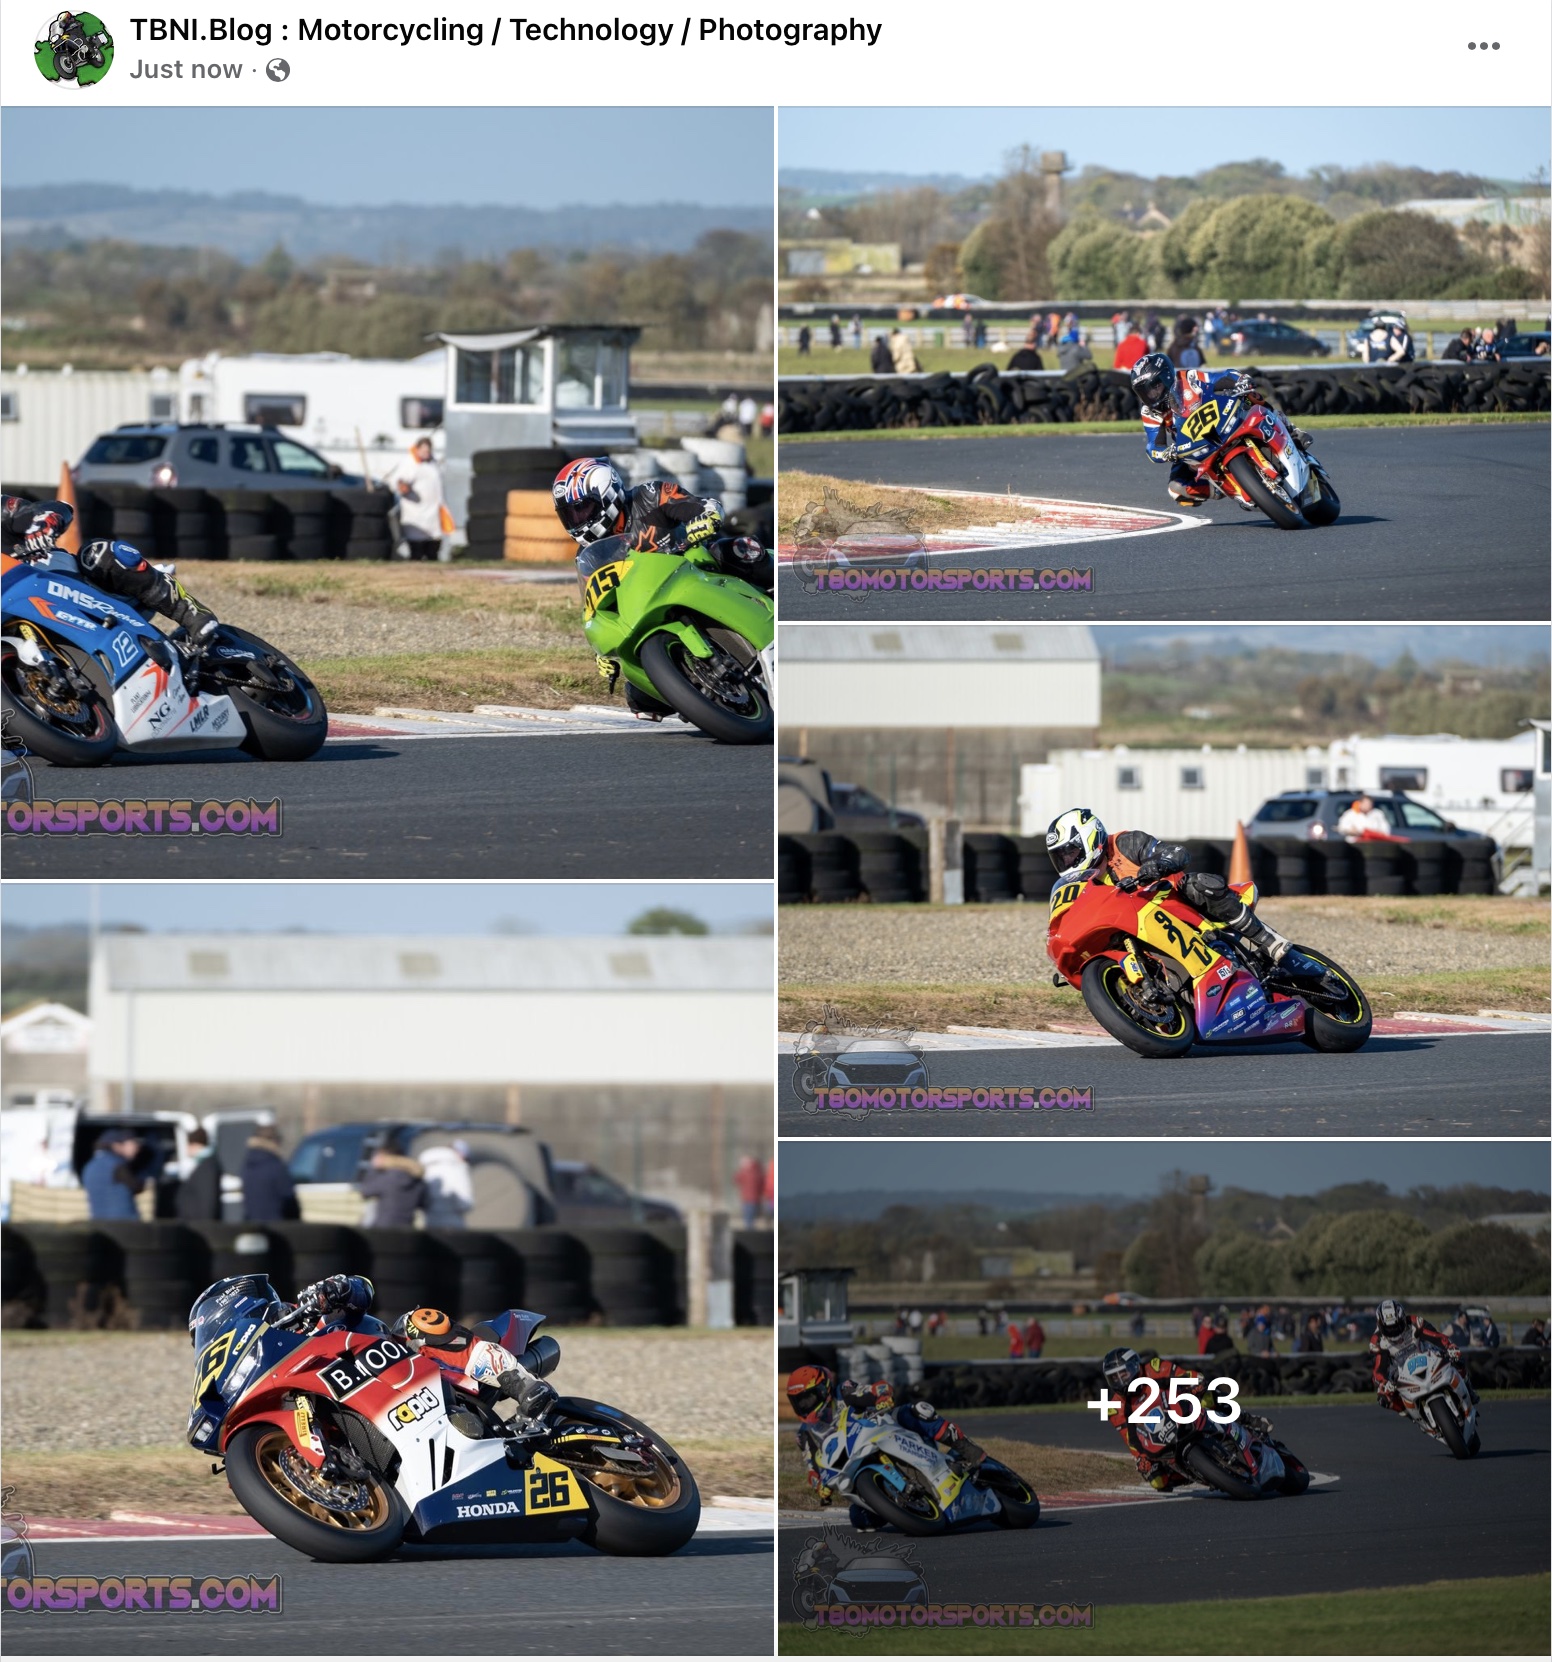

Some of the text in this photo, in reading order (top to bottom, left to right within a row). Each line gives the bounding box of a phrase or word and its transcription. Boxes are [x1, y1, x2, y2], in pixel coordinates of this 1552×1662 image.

[130, 18, 272, 47] TBNI.Blog
[300, 17, 483, 47] Motorcycling
[509, 18, 674, 47] Technology
[700, 17, 883, 47] Photography
[129, 59, 243, 79] Just now
[1187, 403, 1218, 441] 26
[112, 631, 138, 667] 12
[147, 702, 171, 729] NG
[1052, 884, 1080, 910] 20
[387, 1386, 440, 1432] rapid
[893, 1434, 939, 1462] PARKER
[530, 1471, 571, 1510] 26
[456, 1501, 520, 1518] HONDA
